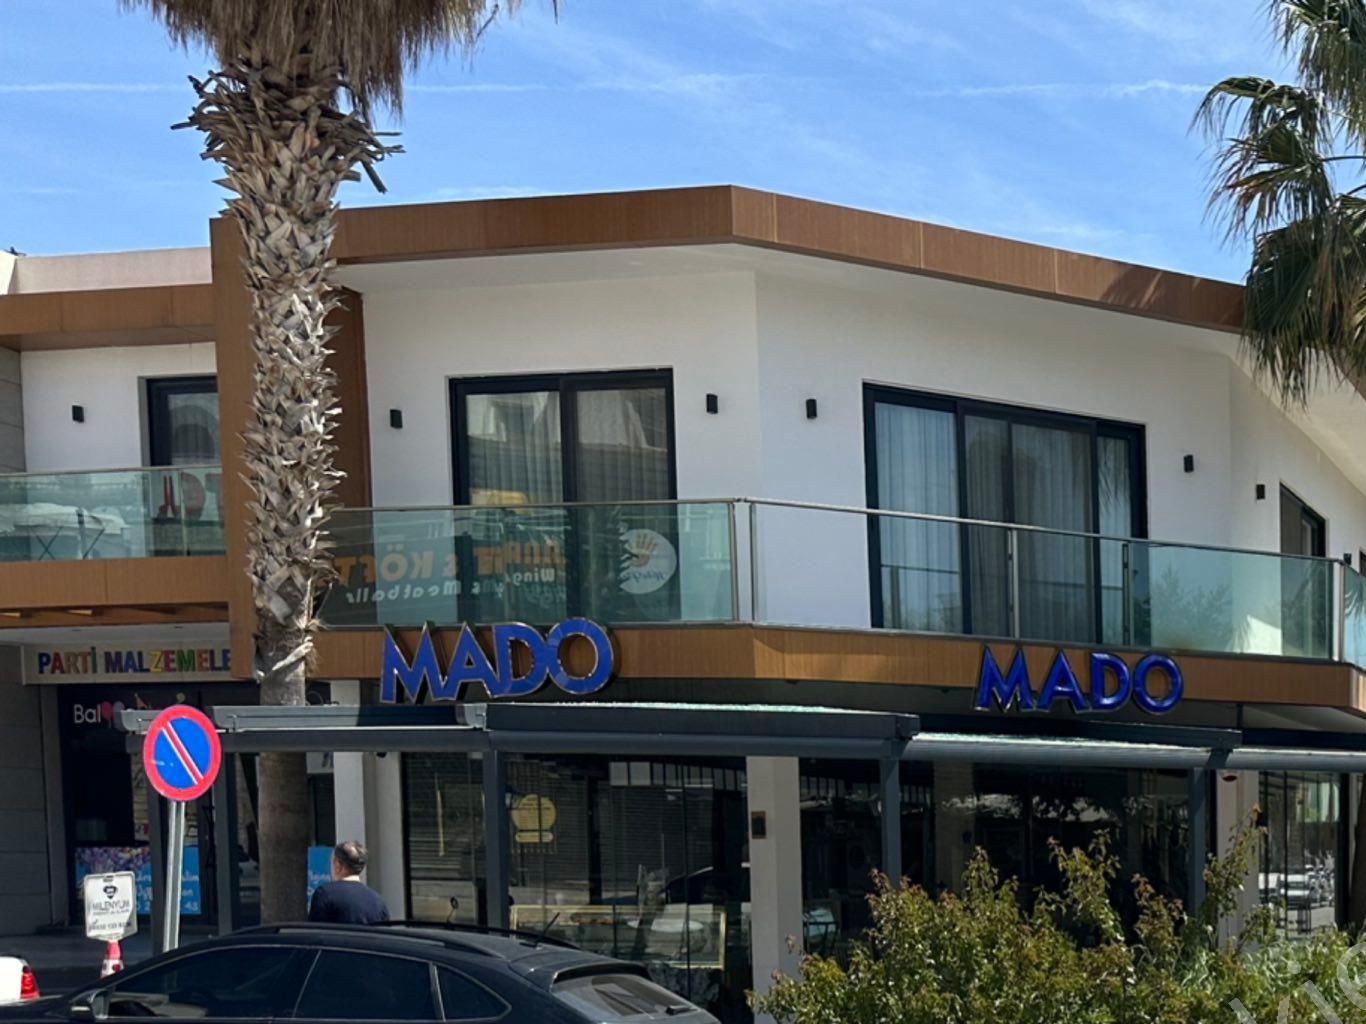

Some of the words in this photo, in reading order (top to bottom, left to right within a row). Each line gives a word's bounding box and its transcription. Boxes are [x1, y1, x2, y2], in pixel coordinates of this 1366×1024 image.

[38, 646, 97, 675] PARTİ
[380, 617, 614, 704] MADO
[974, 646, 1184, 715] MADO
